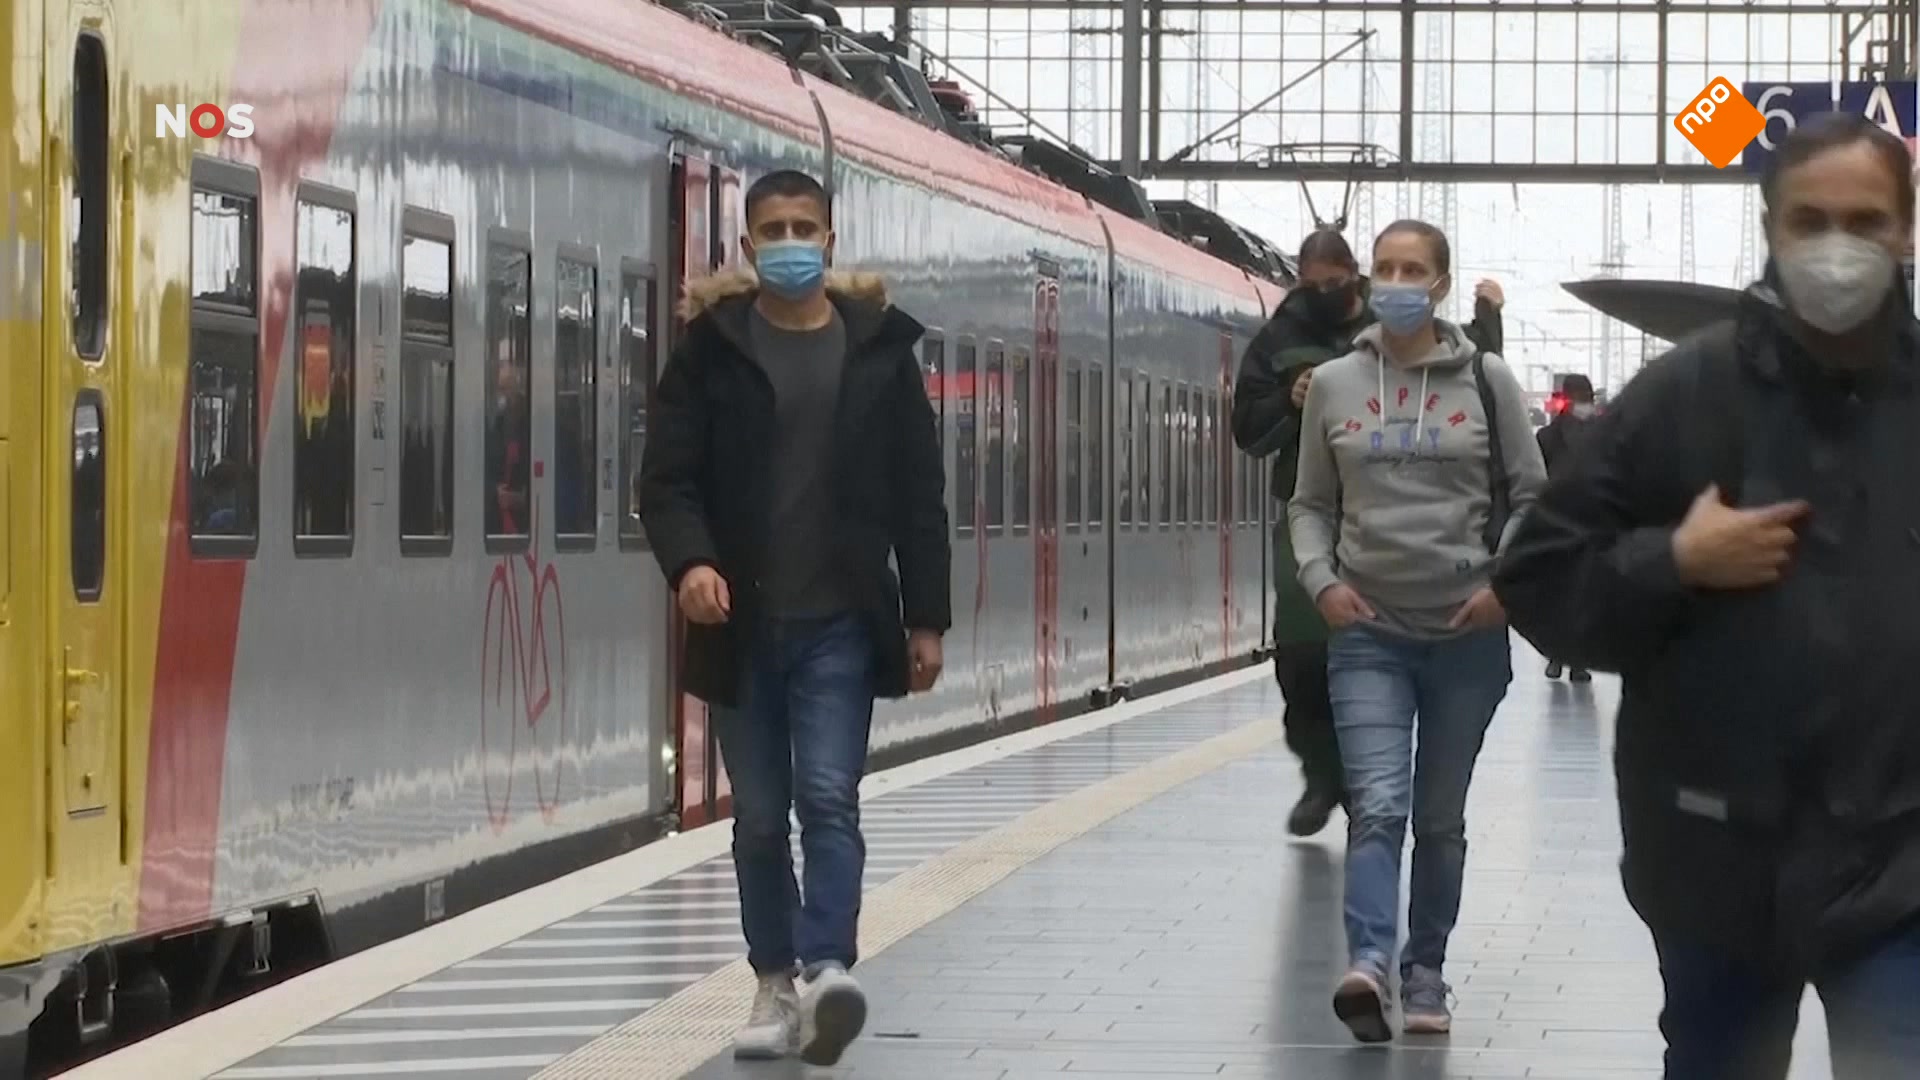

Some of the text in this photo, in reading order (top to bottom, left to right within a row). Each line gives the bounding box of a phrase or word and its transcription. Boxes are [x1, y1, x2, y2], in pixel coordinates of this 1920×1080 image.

[1756, 86, 1796, 151] 6
[1864, 85, 1905, 142] A
[1345, 387, 1467, 432] SUPER
